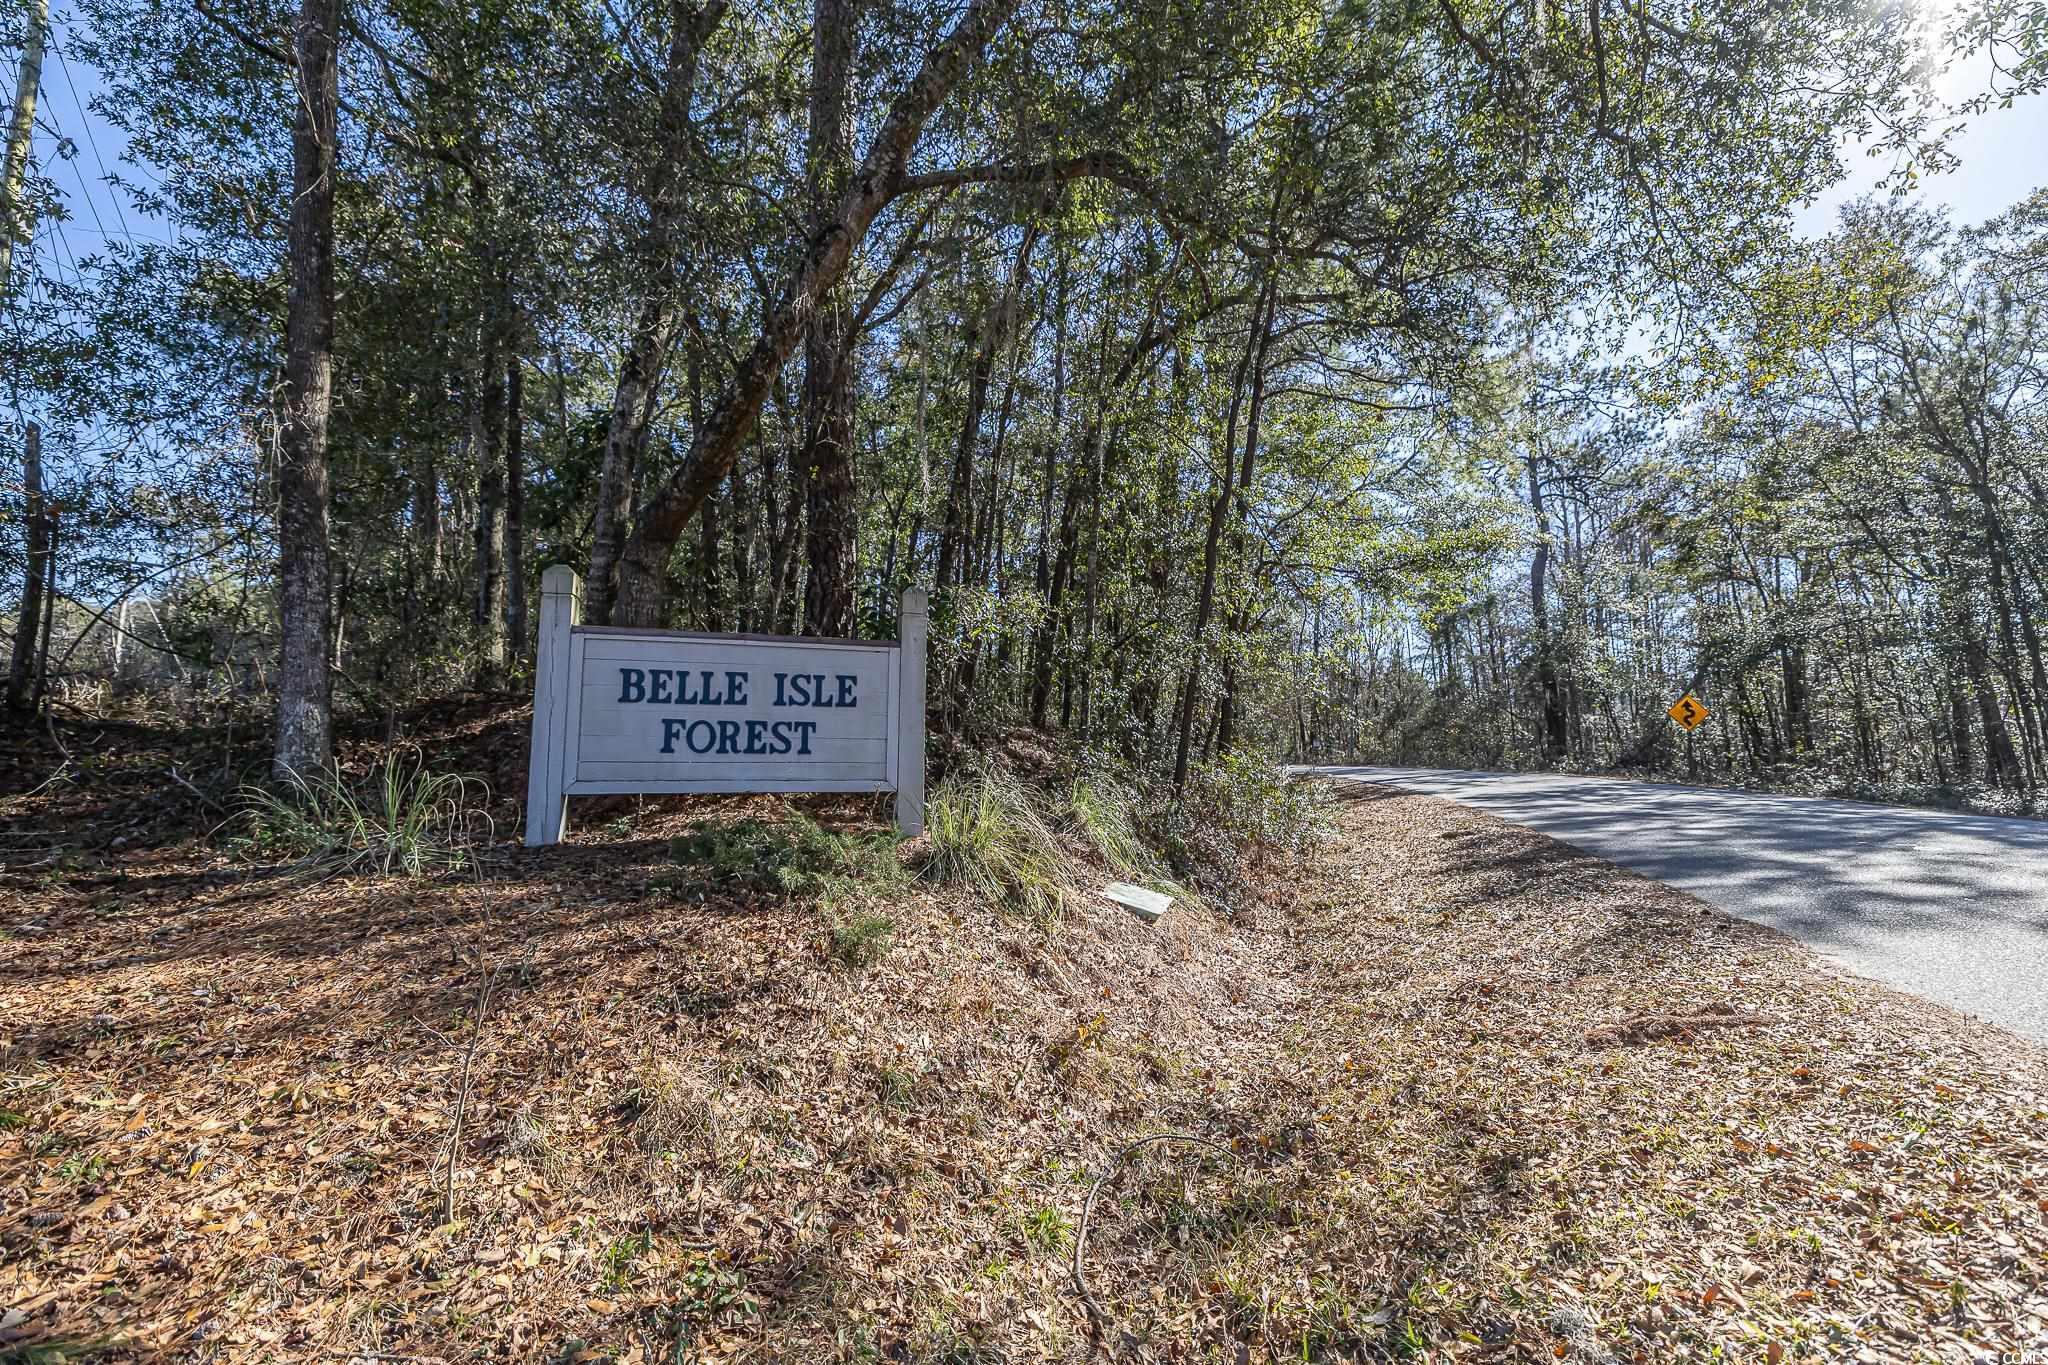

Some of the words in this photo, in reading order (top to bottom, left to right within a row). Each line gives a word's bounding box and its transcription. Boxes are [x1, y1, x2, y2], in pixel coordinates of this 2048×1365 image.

[618, 668, 748, 705] BELLE
[773, 673, 857, 707] ISLE
[660, 718, 816, 754] FOREST
